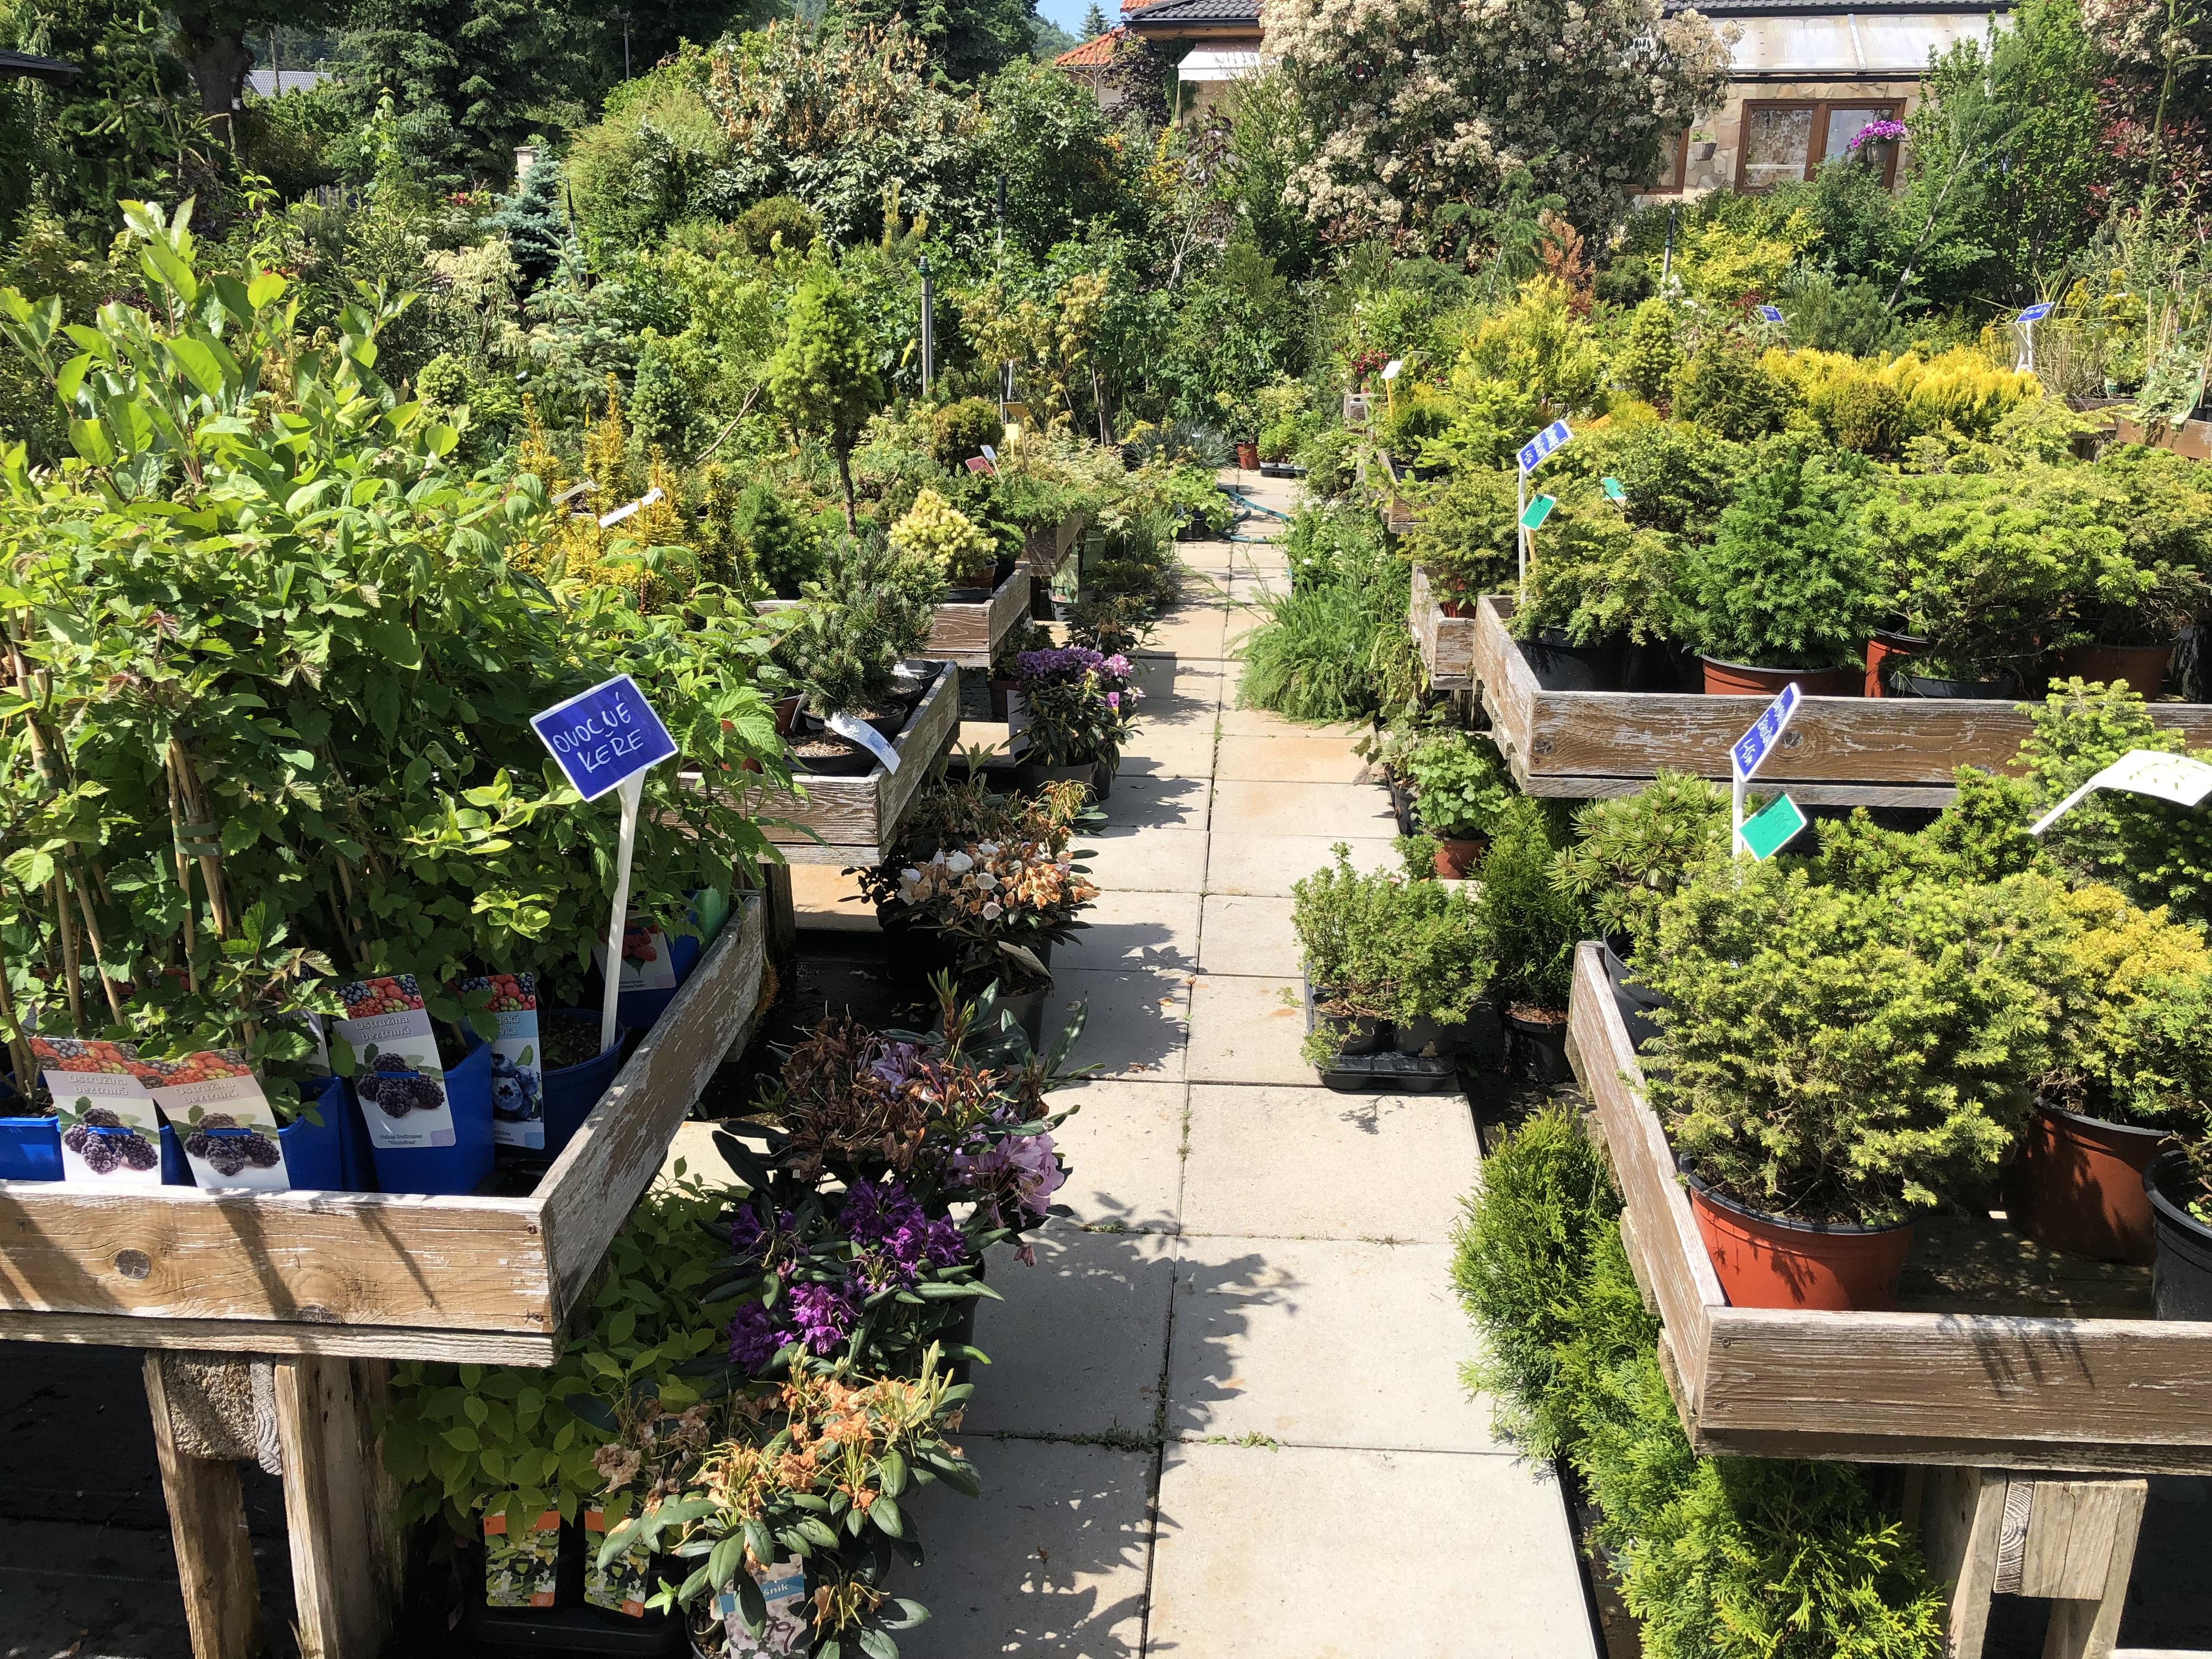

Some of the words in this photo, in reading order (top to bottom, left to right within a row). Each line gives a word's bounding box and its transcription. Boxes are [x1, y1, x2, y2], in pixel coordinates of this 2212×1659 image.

[552, 691, 631, 753] OVOCNÉ
[577, 730, 644, 774] KEŘE
[355, 1016, 409, 1030] Ostružina
[361, 1026, 411, 1041] beztrnná
[67, 1074, 128, 1086] Ostružina
[75, 1085, 129, 1095] beztrnná
[175, 1081, 236, 1095] Ostružina
[182, 1089, 239, 1104] beztrnná
